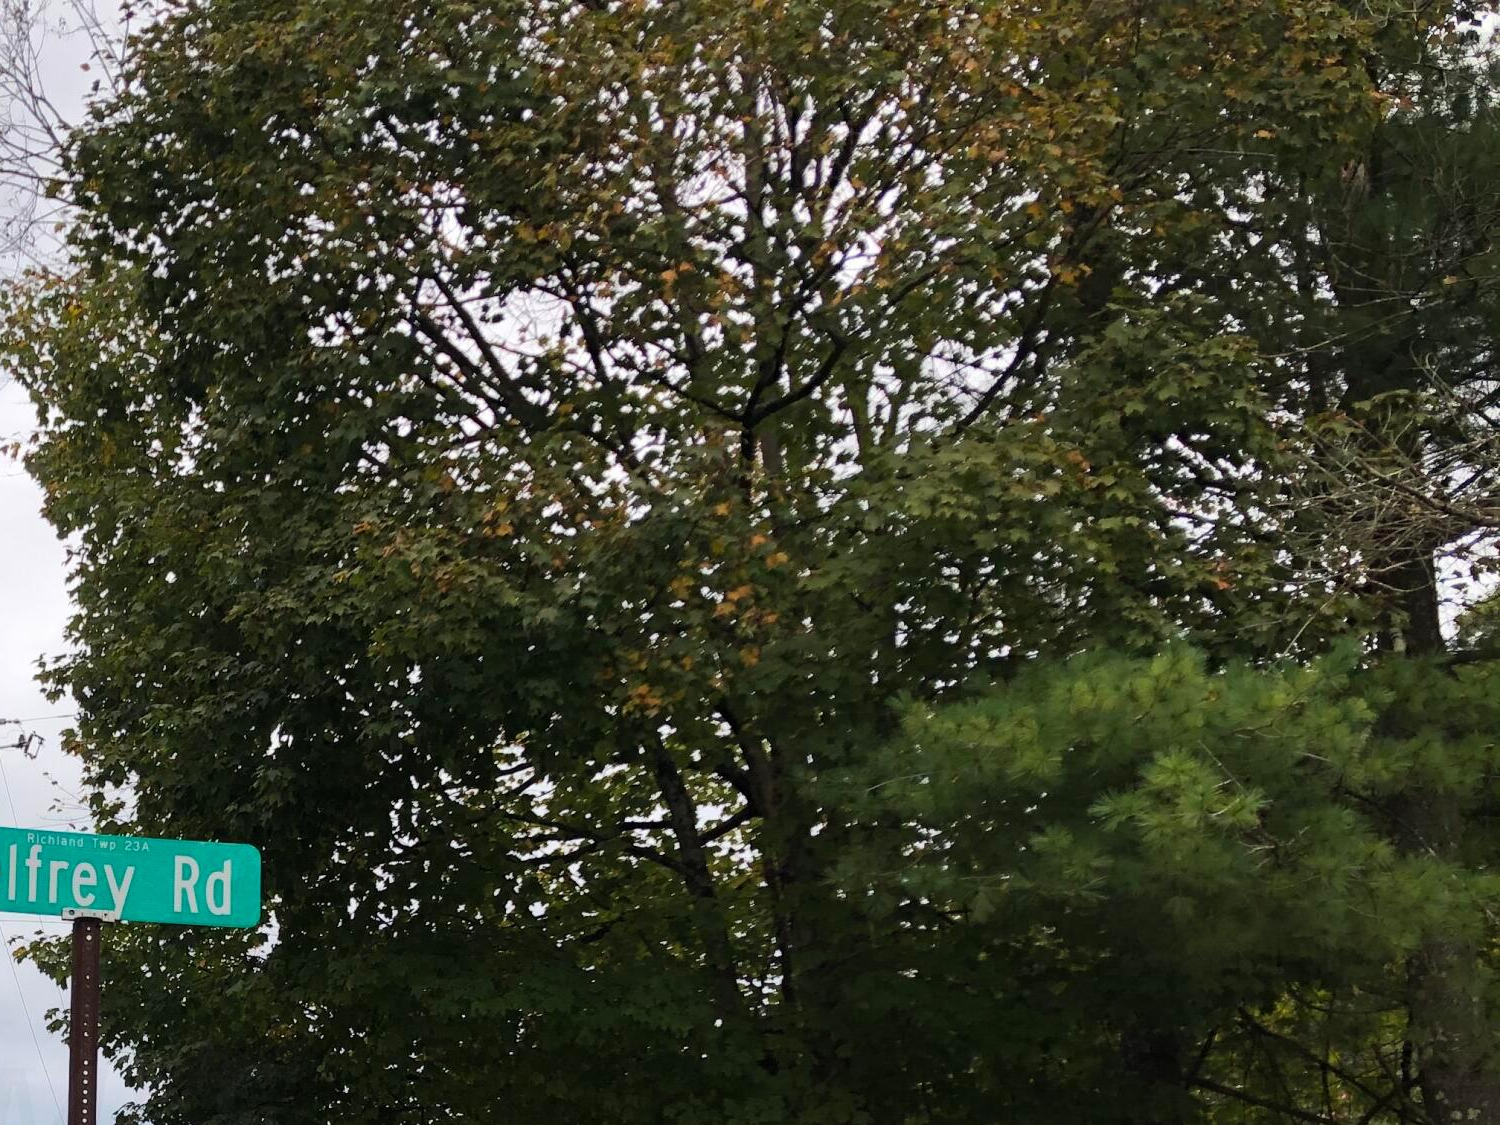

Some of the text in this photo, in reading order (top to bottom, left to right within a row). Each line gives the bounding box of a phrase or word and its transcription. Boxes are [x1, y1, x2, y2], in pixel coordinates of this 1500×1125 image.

[27, 833, 150, 852] Richland Twp 23A
[173, 855, 232, 916] Rd
